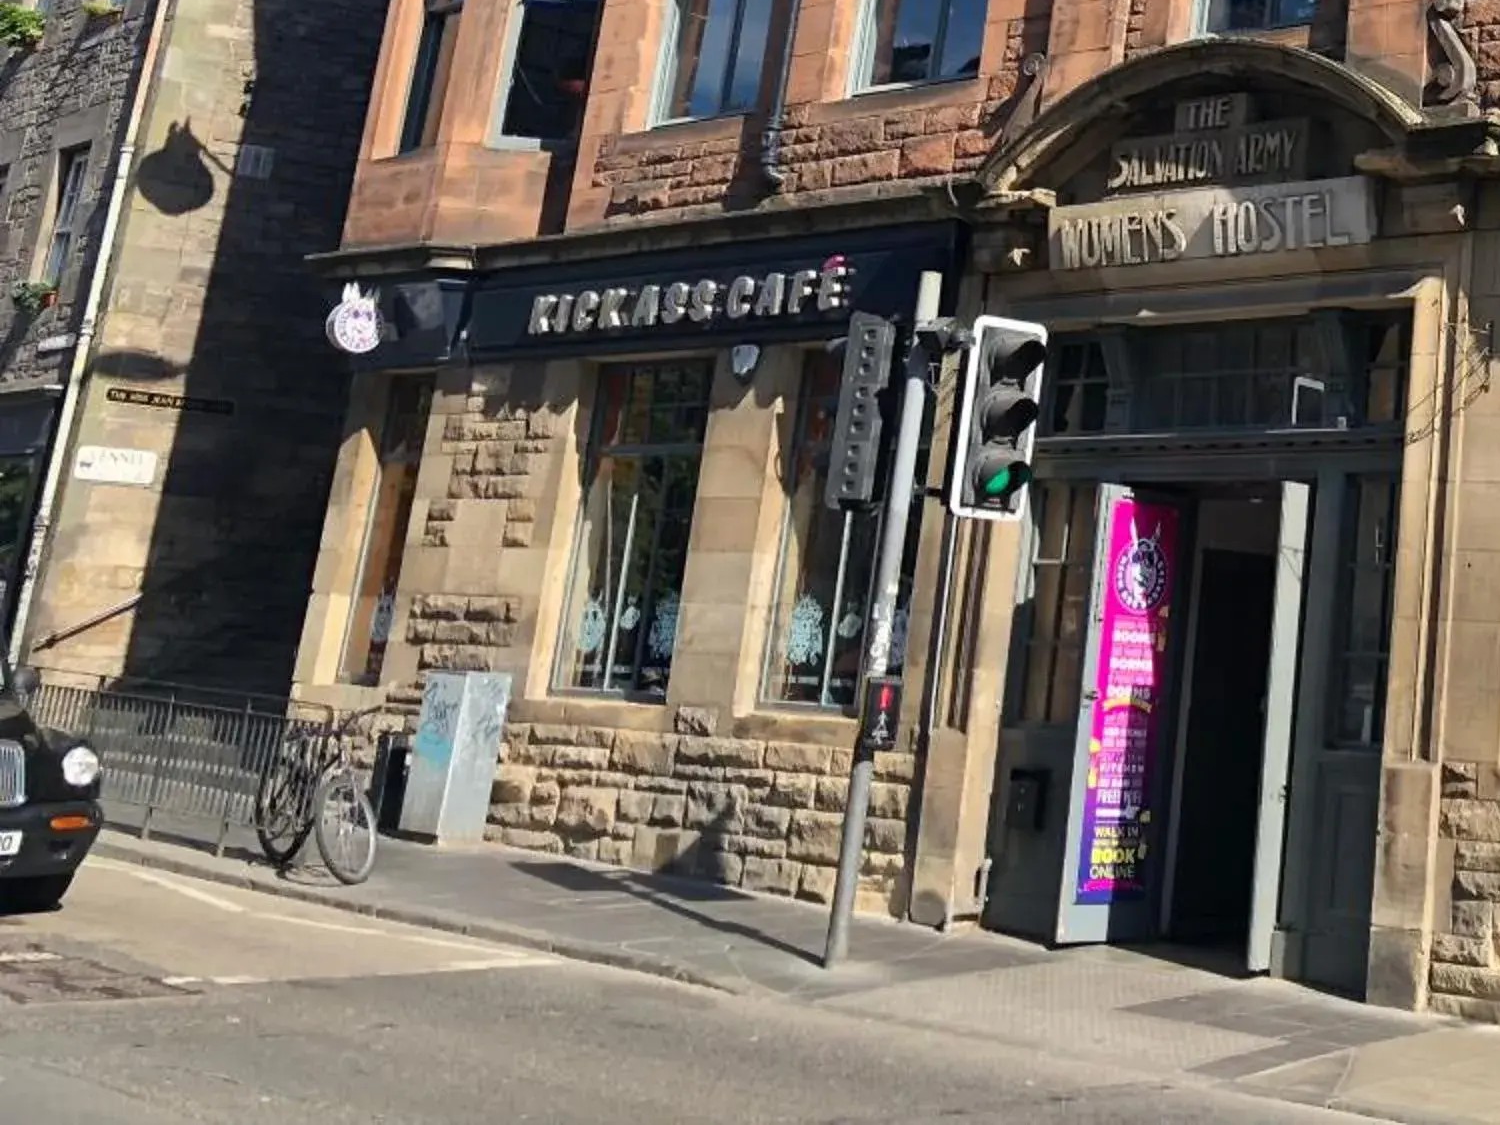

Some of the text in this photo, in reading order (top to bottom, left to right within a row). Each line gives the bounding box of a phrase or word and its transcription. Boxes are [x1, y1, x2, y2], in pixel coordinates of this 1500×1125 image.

[1186, 97, 1232, 129] THE
[1106, 129, 1297, 189] SALVATION ARMY
[1211, 189, 1349, 255] HOSTEL
[1090, 847, 1135, 864] BOOK
